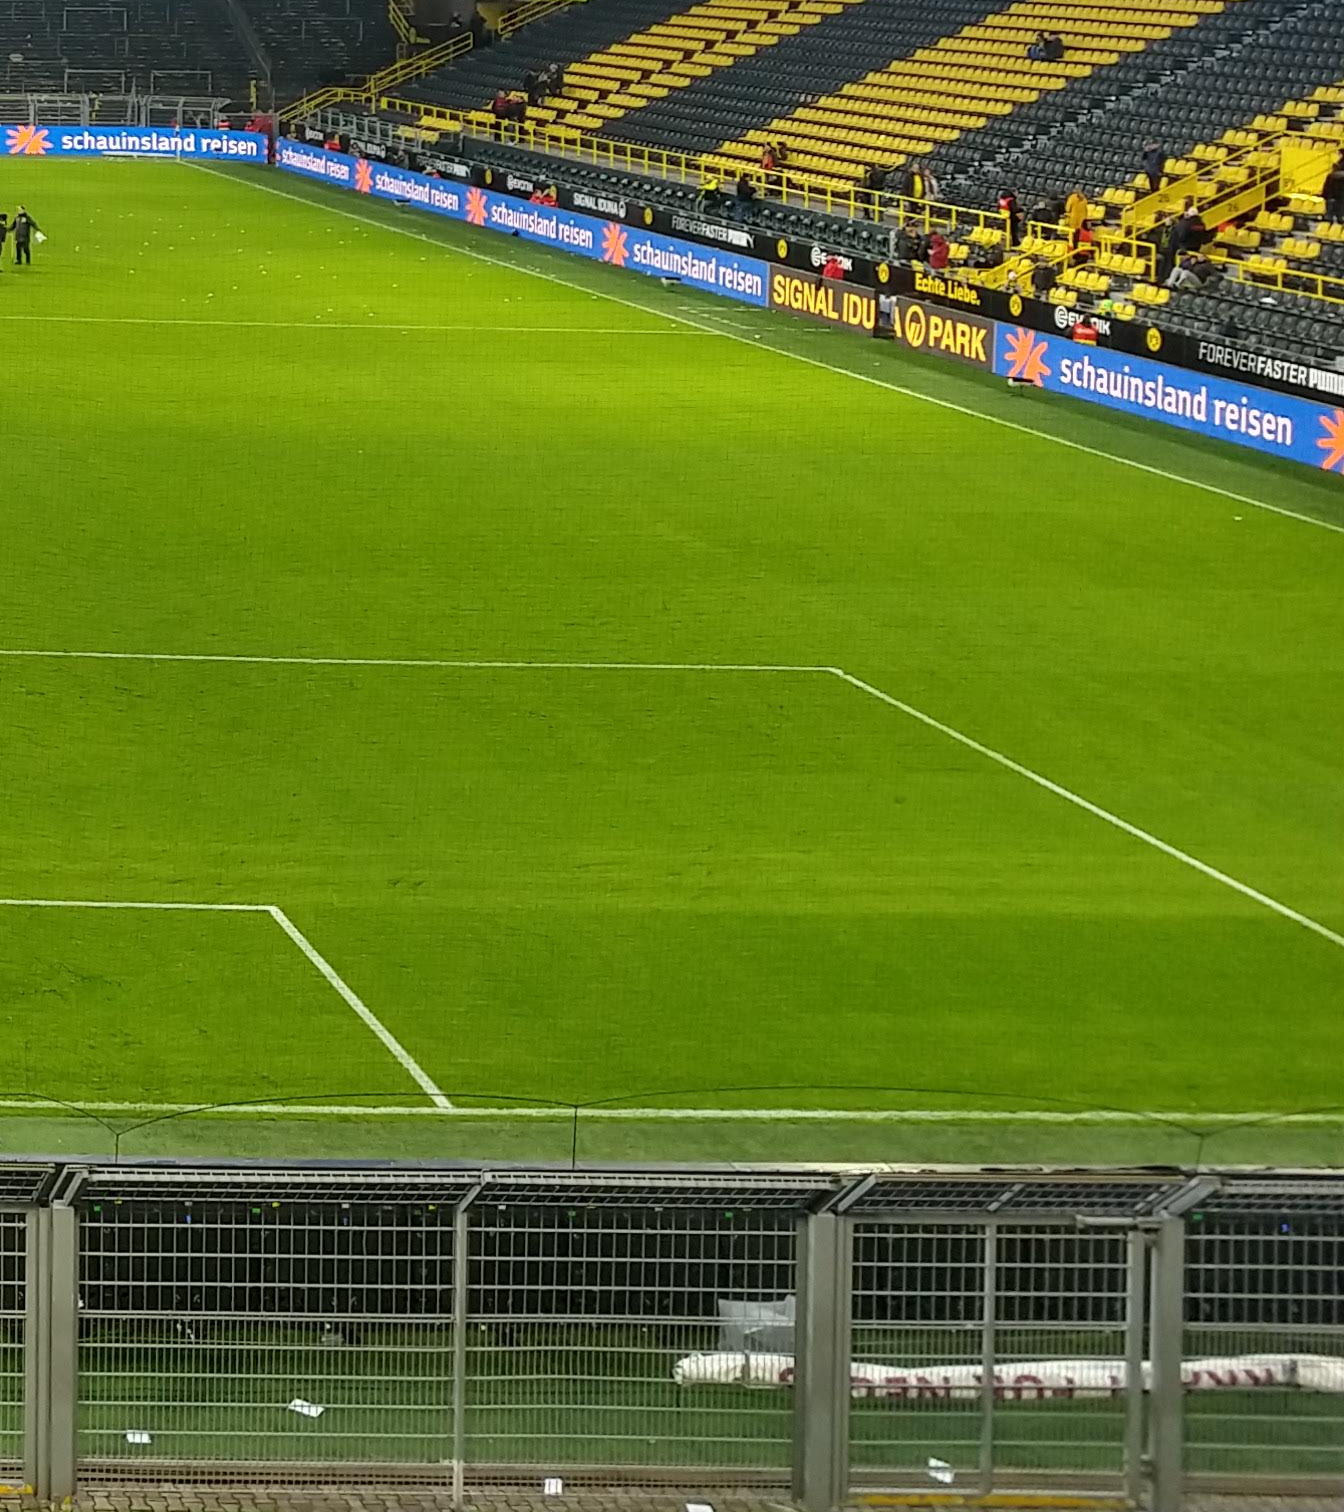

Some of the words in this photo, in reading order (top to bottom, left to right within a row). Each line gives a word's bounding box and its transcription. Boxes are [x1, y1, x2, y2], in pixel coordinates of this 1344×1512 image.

[62, 131, 193, 153] schauinsland
[201, 135, 257, 156] reisen
[282, 146, 326, 175] schauinsland
[326, 158, 350, 181] reisen
[376, 172, 429, 203] schauinsland
[430, 185, 459, 211] reisen
[573, 192, 597, 210] SIGNAL
[597, 197, 619, 215] IDUNA
[491, 201, 557, 239] schauinsland
[558, 219, 593, 249] reisen
[633, 240, 716, 289] schauinsland
[718, 263, 762, 297] reisen
[914, 273, 946, 297] Echte
[948, 280, 981, 306] Liebe.
[773, 274, 839, 320] SIGNAL
[929, 315, 987, 362] PARK
[1060, 355, 1207, 422] schauinsland
[1213, 396, 1293, 446] reisen
